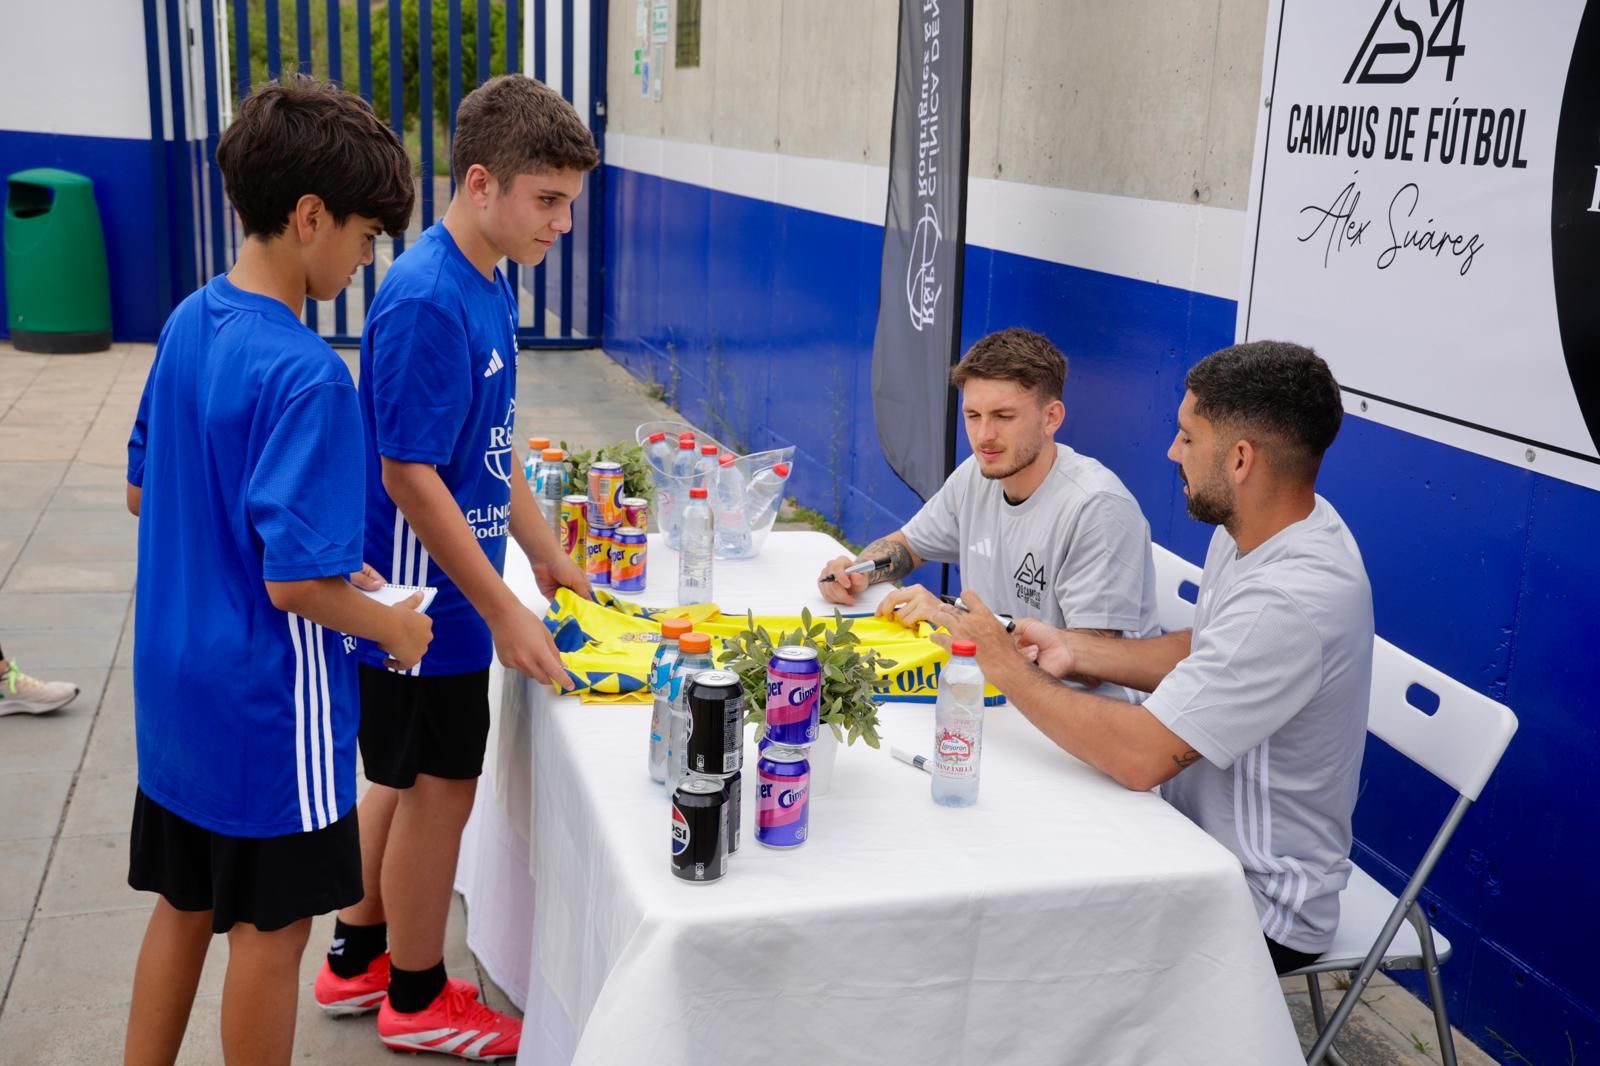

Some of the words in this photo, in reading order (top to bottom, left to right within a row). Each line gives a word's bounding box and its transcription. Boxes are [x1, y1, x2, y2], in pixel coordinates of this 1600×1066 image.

[1287, 104, 1379, 159] CAMPUS
[1384, 107, 1419, 161] DE
[1424, 97, 1528, 169] FÚTBOL
[1297, 170, 1371, 269] Álex
[1377, 183, 1484, 276] Suárez
